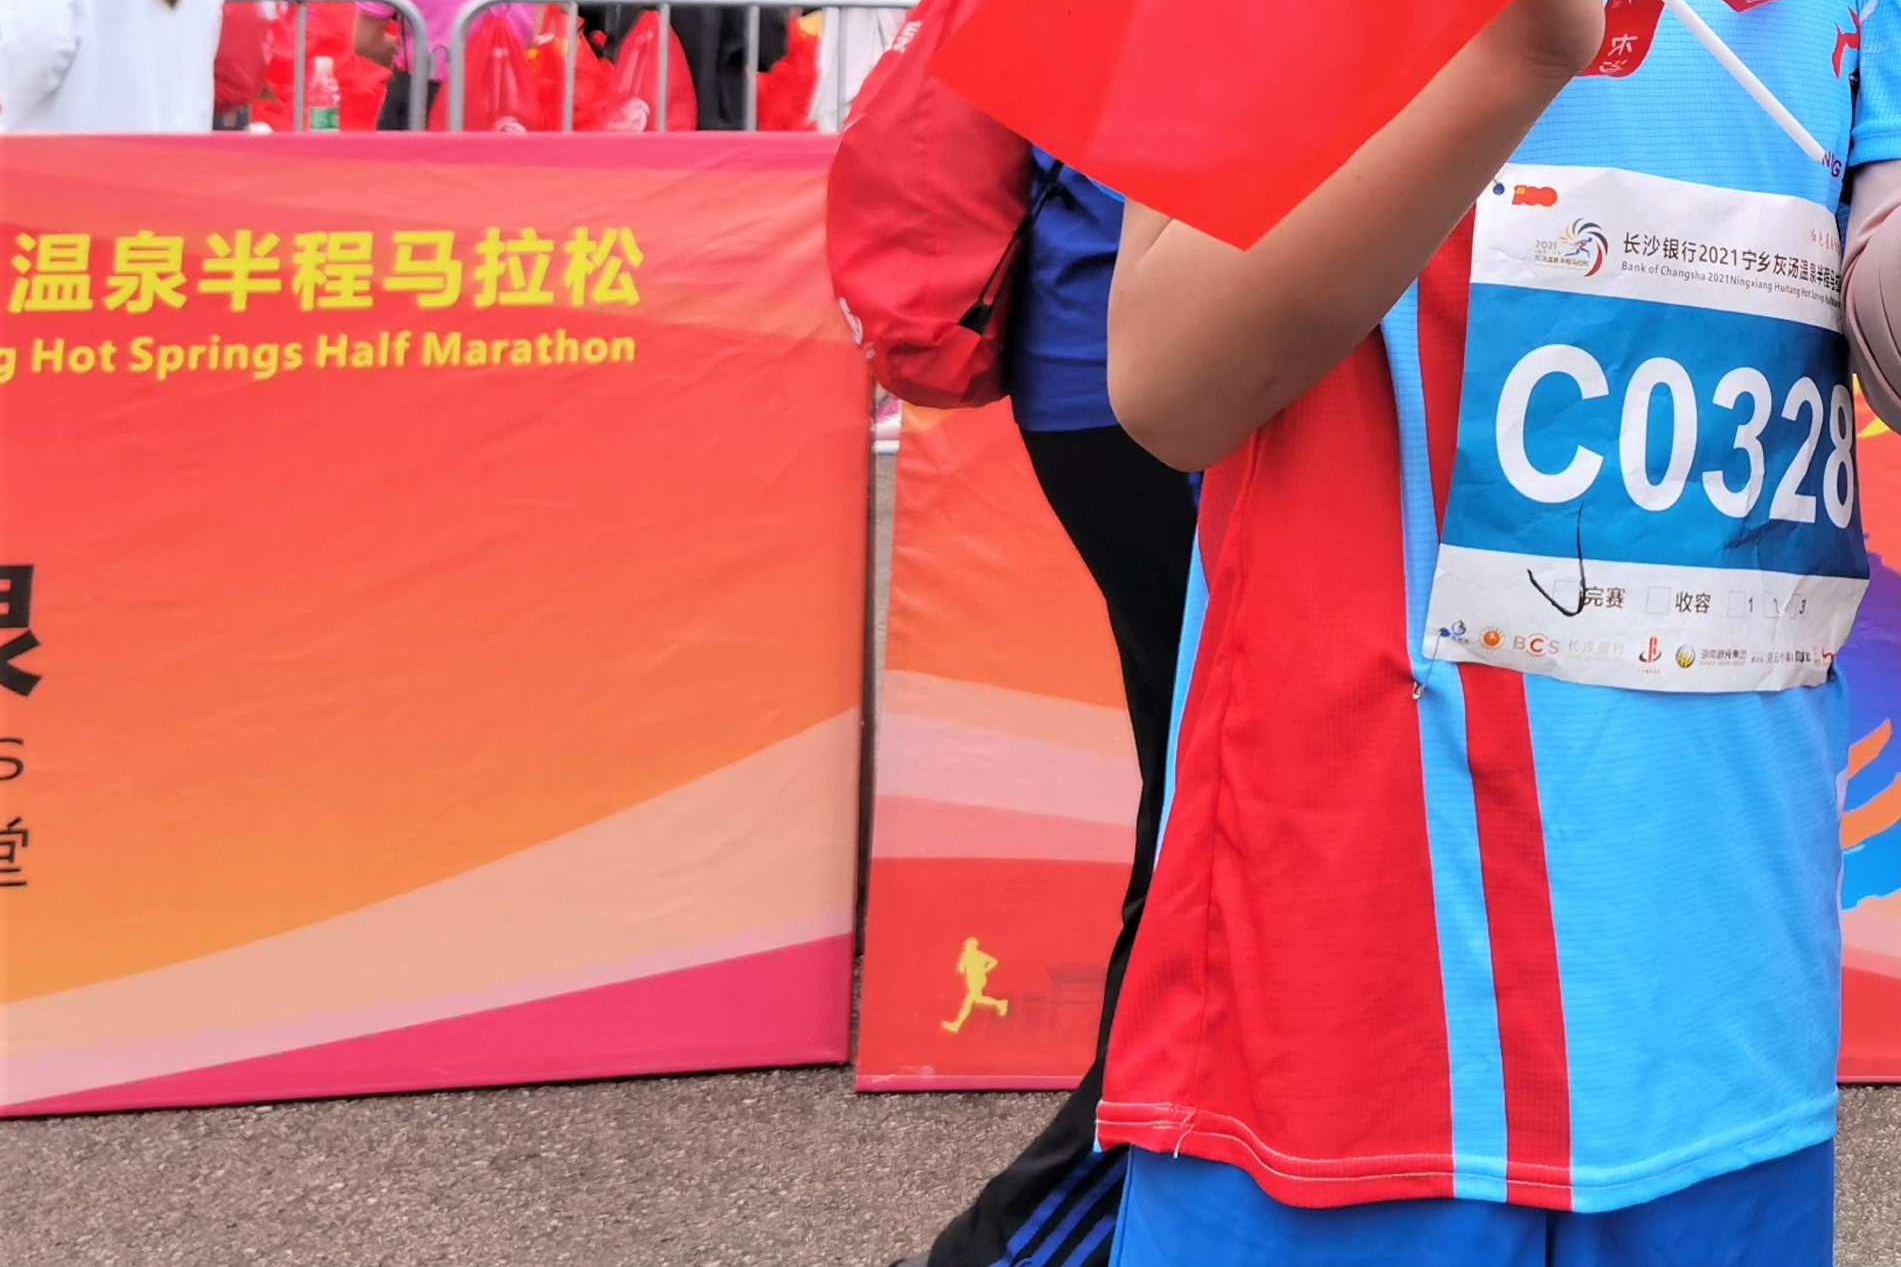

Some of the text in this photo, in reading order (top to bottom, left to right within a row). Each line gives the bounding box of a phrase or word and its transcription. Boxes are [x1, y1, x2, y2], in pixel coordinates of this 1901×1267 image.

[8, 226, 645, 313] 温泉半程马拉松
[1621, 260, 1646, 274] Bank
[1648, 264, 1659, 275] of
[1660, 265, 1706, 282] Changsha
[32, 337, 116, 374] Hot
[127, 335, 304, 381] Springs
[316, 330, 411, 369] Half
[422, 329, 637, 368] Marathon
[1495, 343, 1853, 529] C0328
[1584, 586, 1627, 610] 完赛
[1675, 591, 1711, 615] 收容
[1513, 634, 1560, 655] BCS
